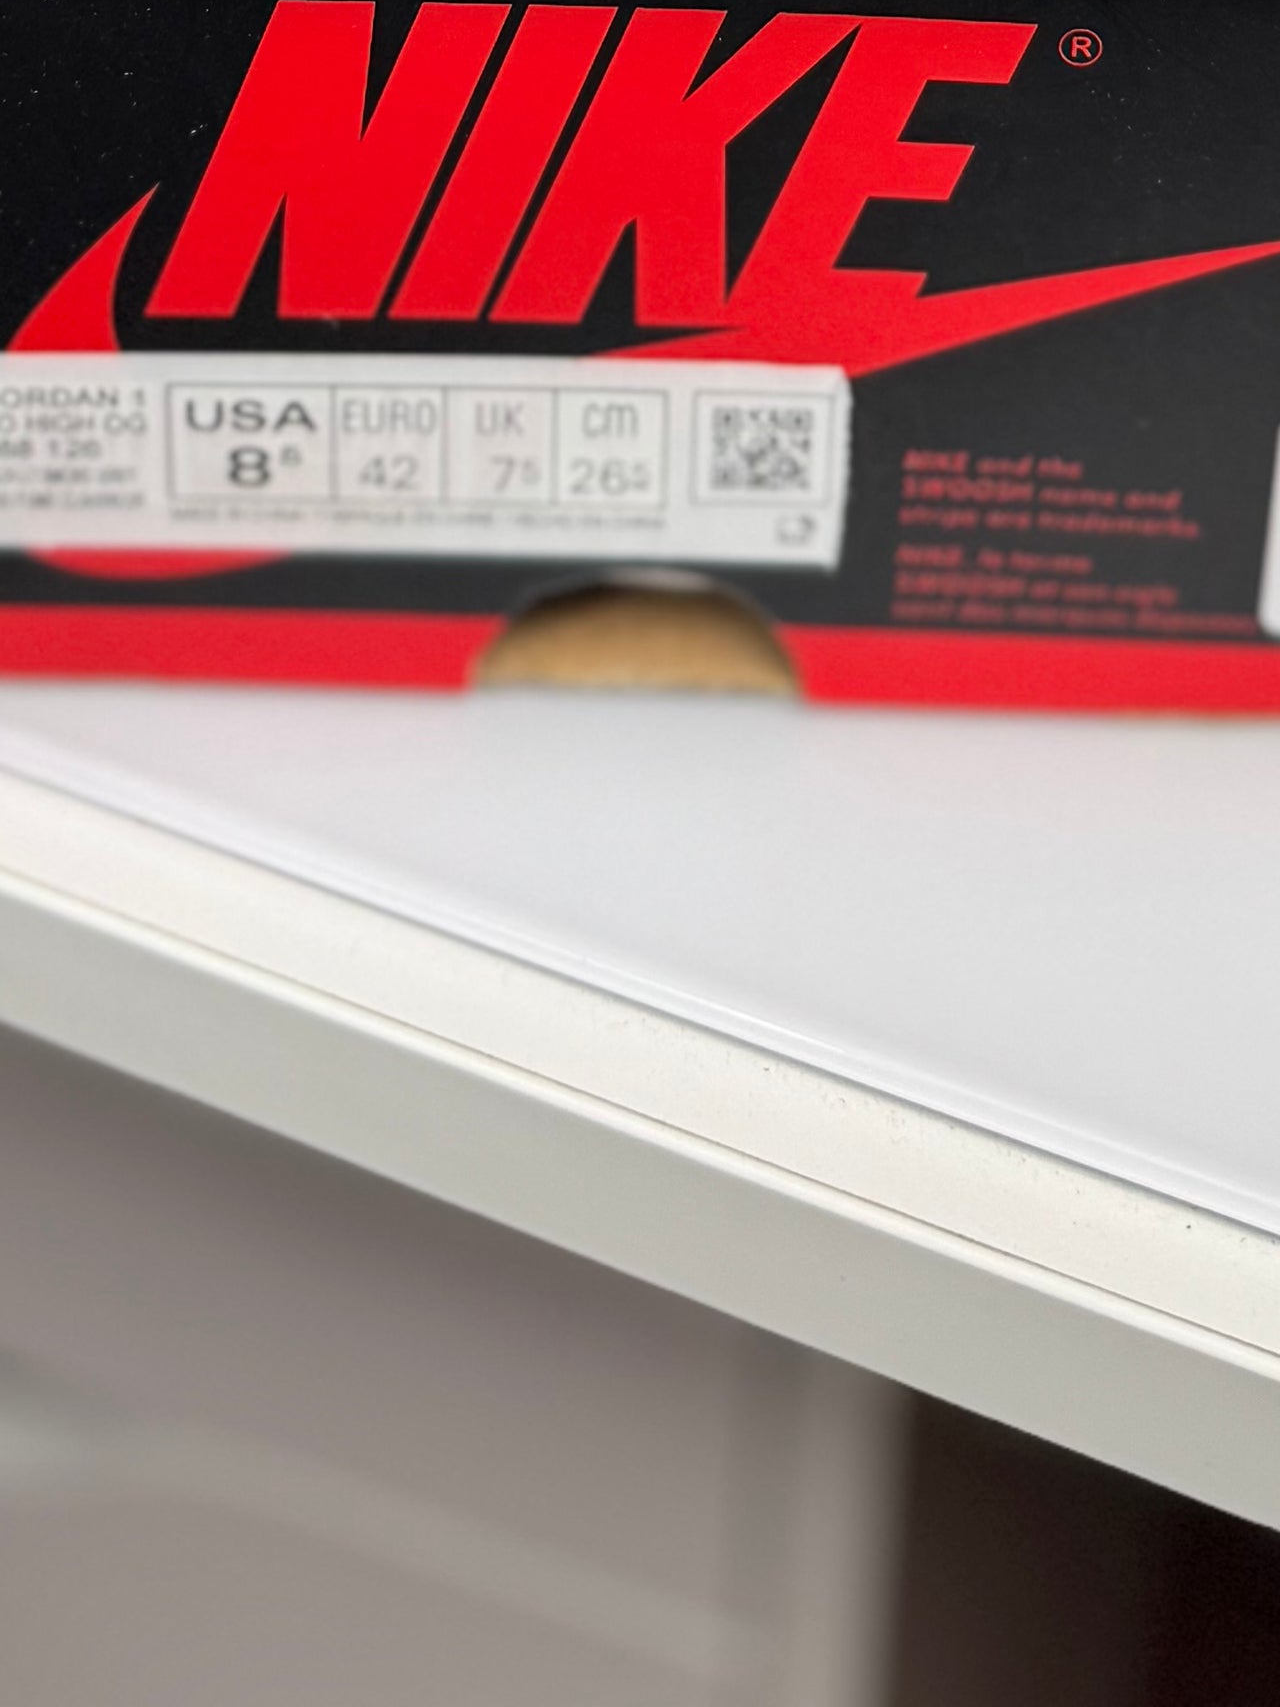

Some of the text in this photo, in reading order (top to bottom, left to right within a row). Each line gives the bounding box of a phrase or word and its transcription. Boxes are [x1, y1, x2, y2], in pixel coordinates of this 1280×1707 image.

[184, 398, 318, 434] USA
[341, 399, 438, 436] EURO
[474, 402, 525, 437] UK
[358, 455, 420, 491] 42
